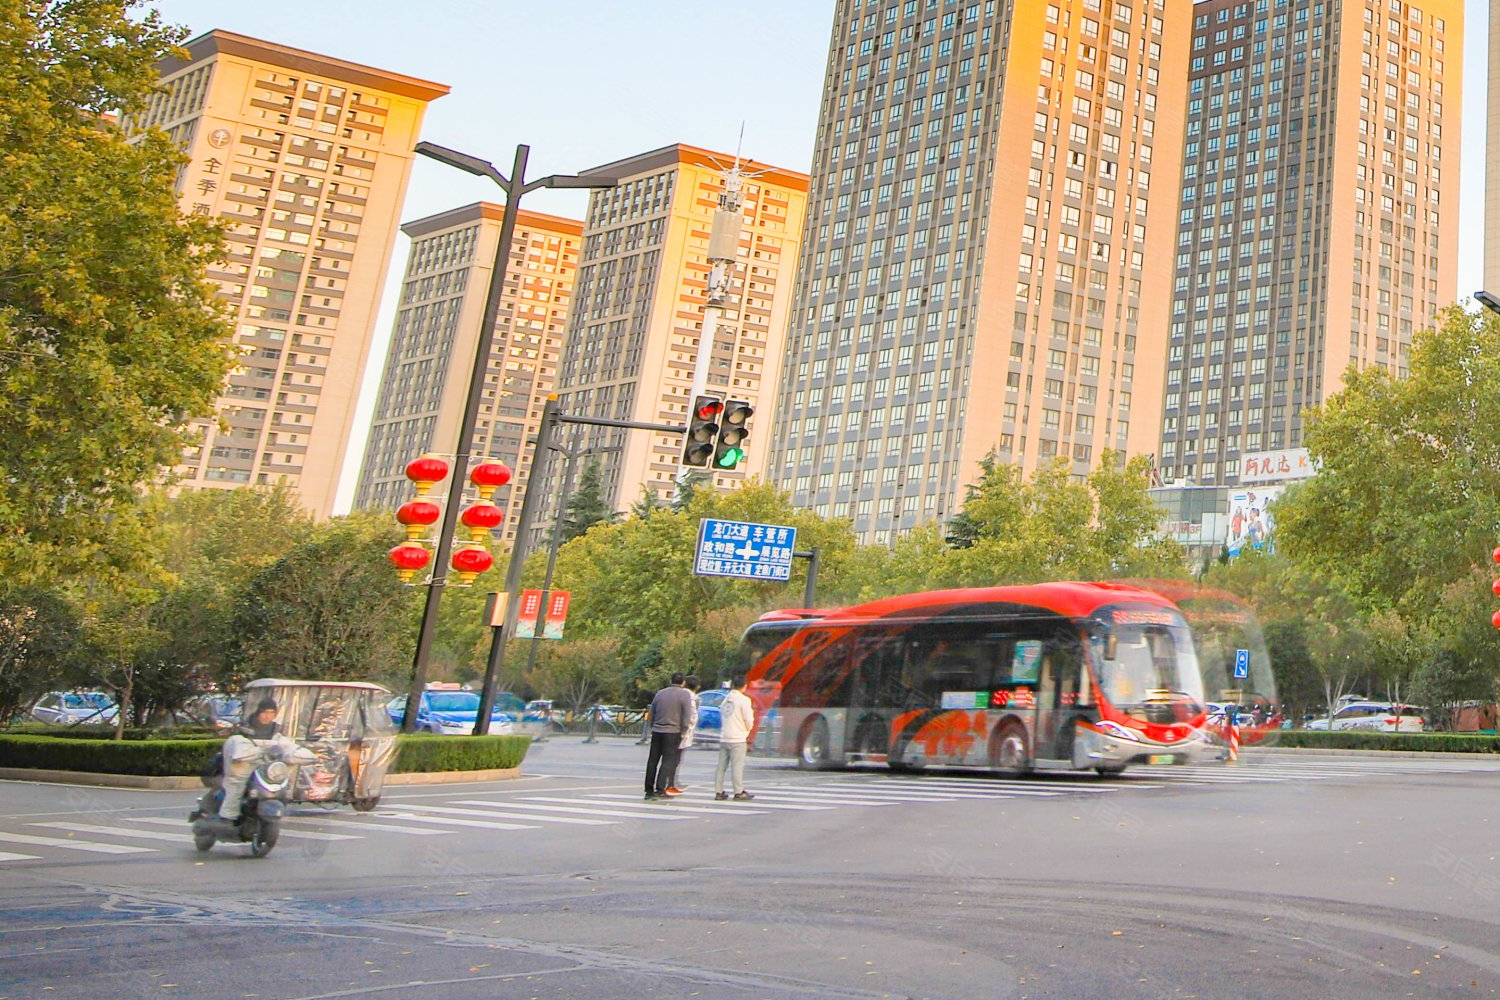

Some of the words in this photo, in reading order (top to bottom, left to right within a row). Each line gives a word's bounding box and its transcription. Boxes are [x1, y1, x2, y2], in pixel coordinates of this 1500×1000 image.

[1245, 454, 1290, 476] 阿凡达
[713, 522, 749, 537] 龙门大道
[753, 526, 789, 540] 车管所
[702, 541, 736, 555] 政和路
